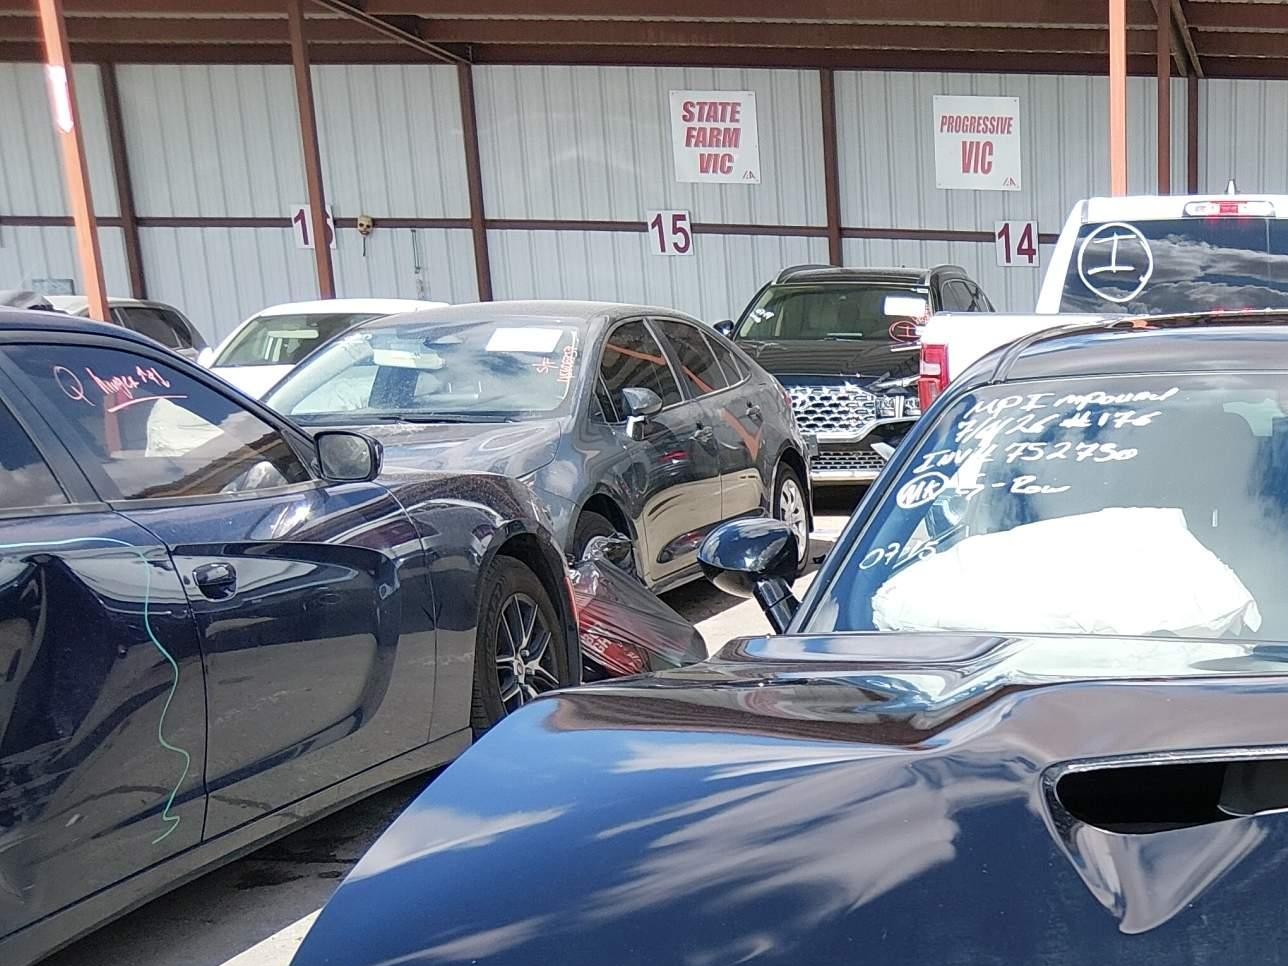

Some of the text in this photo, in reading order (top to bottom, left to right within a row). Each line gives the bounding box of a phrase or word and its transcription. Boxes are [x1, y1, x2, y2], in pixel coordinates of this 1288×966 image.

[682, 100, 742, 123] STATE
[940, 115, 1014, 135] PROGRESSIVE
[685, 127, 742, 149] FARM
[699, 153, 735, 175] VIC
[961, 140, 994, 175] VIC
[651, 213, 690, 254] 15
[997, 222, 1037, 264] 14
